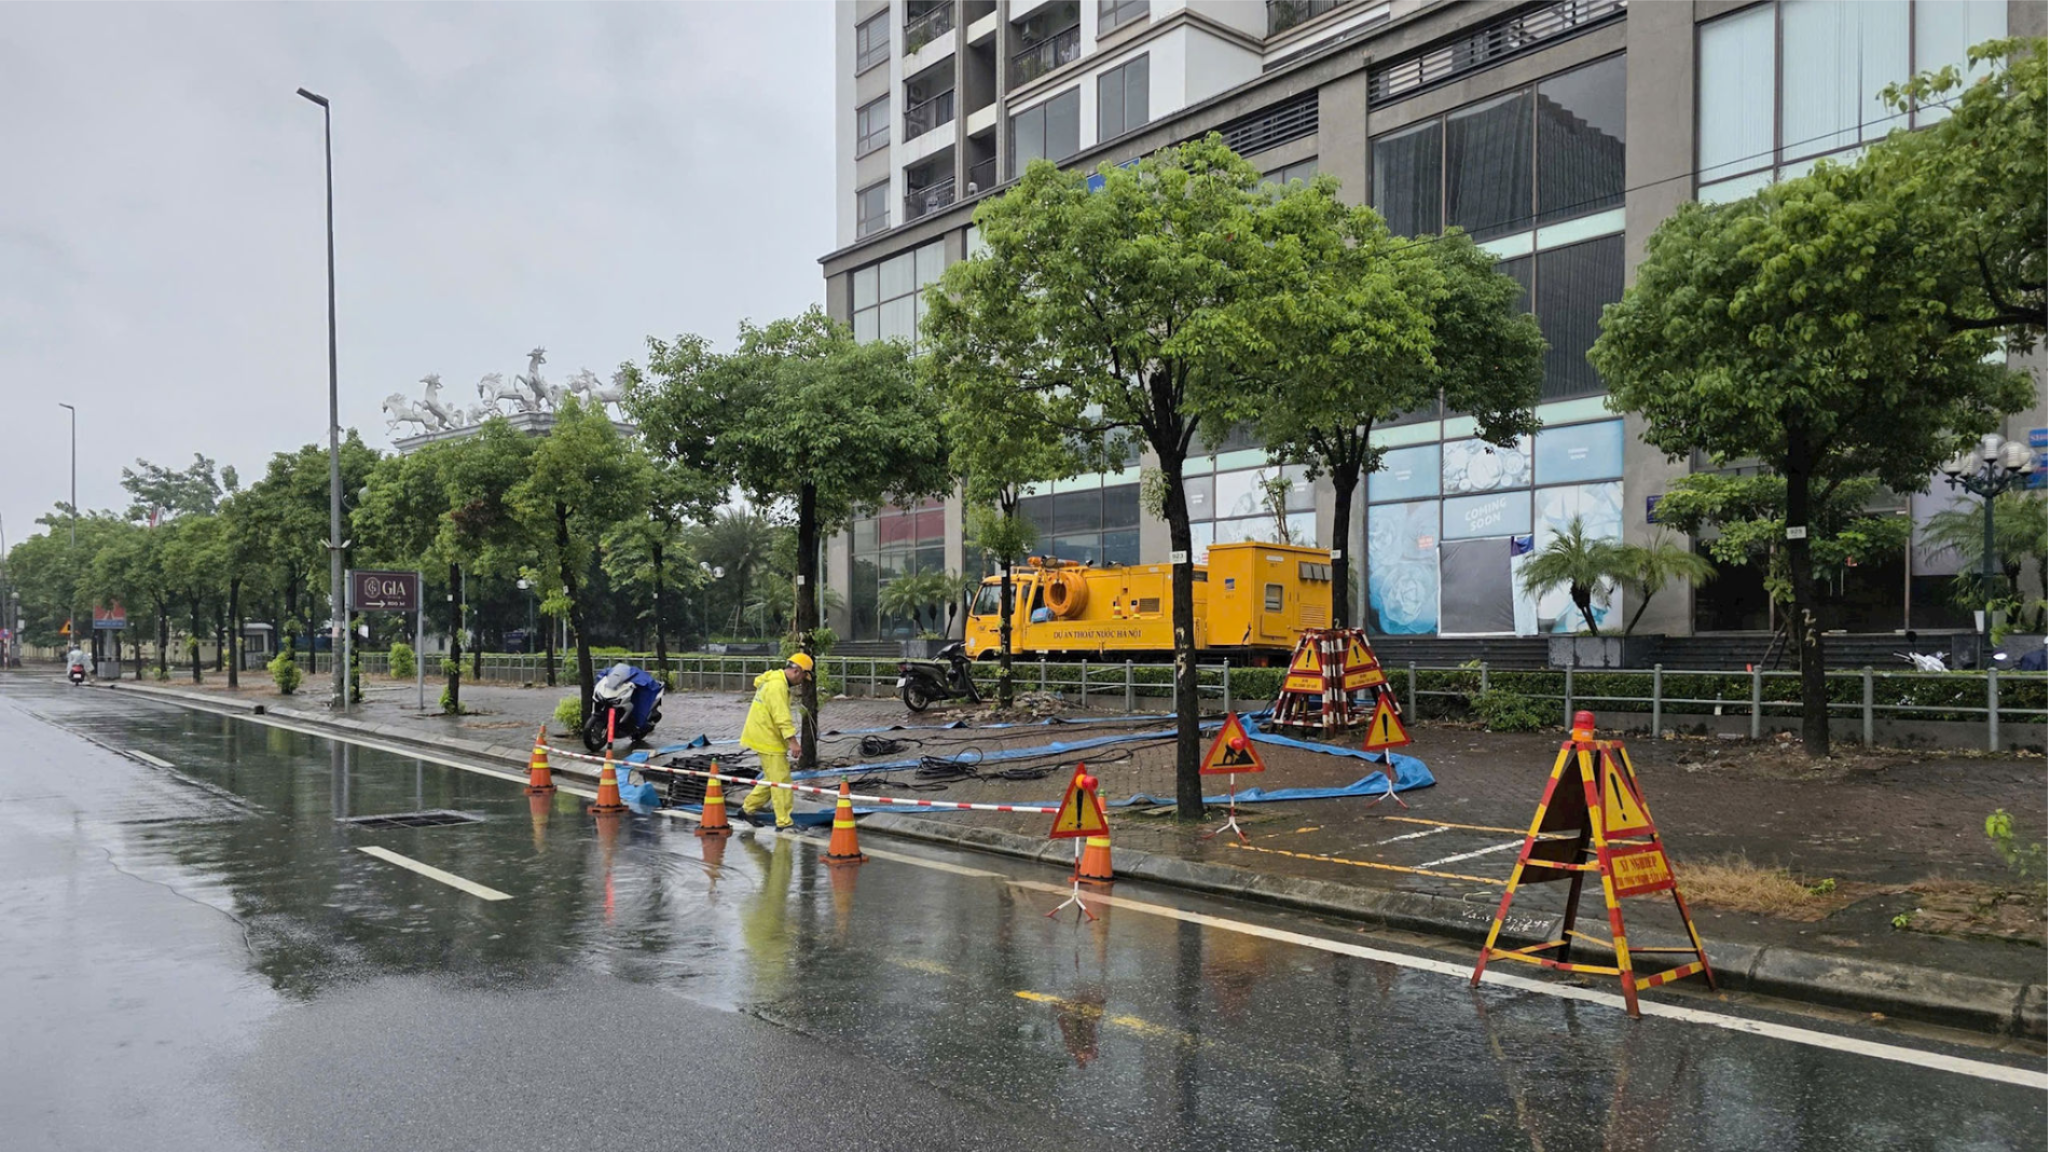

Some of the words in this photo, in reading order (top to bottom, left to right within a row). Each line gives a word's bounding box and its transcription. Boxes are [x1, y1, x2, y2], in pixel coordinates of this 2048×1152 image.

[1465, 497, 1507, 521] COMING
[1470, 512, 1501, 532] SOON
[382, 580, 406, 596] GIA
